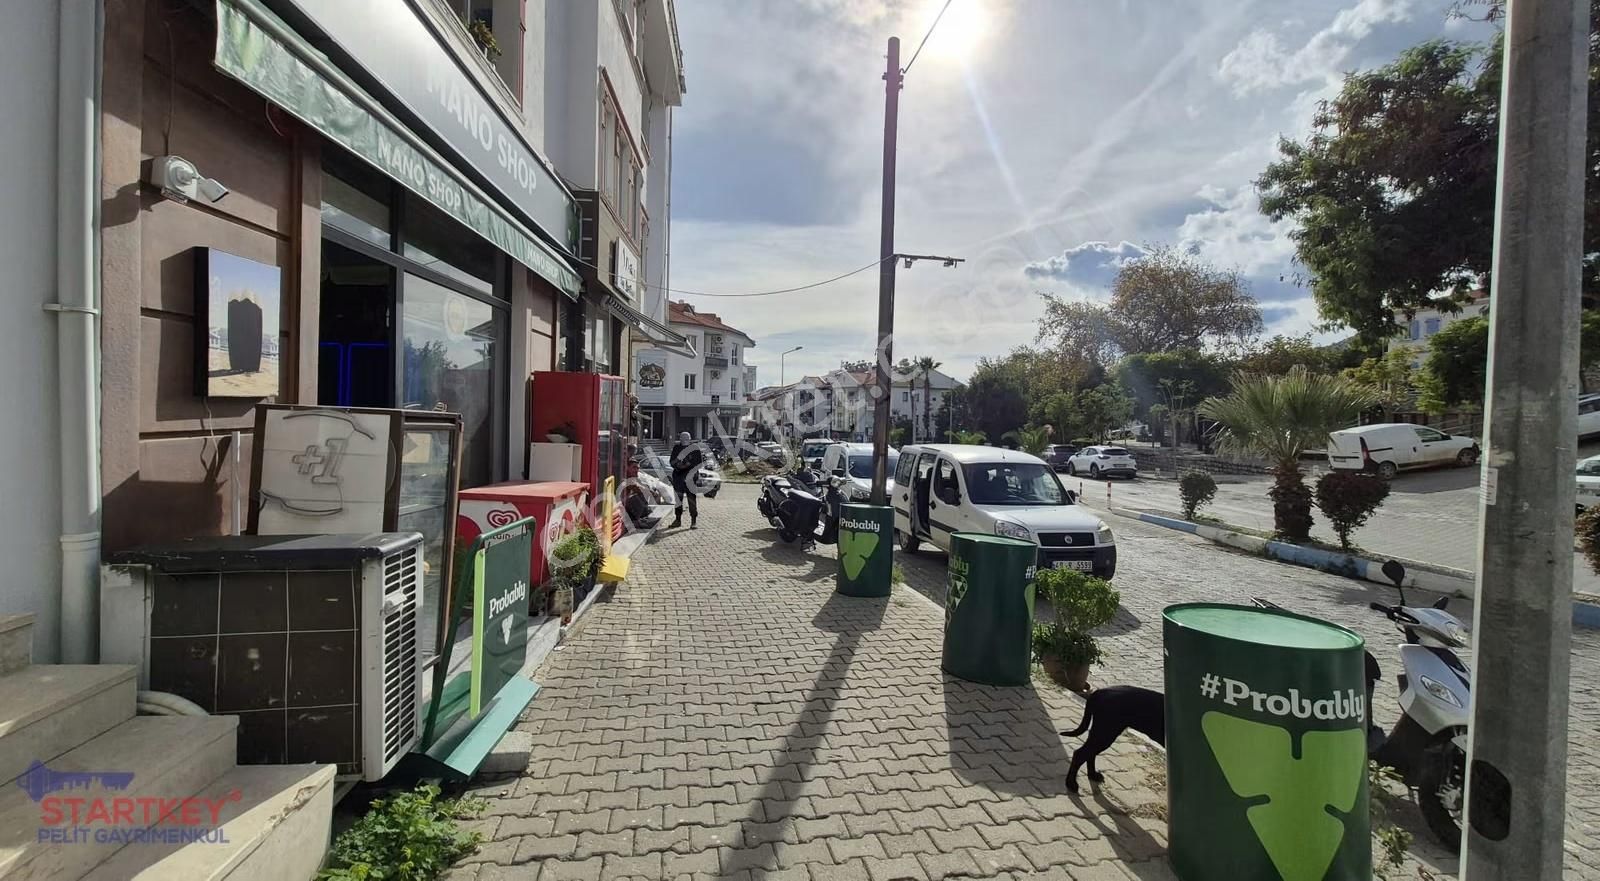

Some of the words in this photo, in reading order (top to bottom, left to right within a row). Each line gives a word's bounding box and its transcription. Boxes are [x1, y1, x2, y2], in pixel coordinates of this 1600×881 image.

[426, 62, 494, 151] MANO
[498, 134, 537, 195] SHOP
[378, 135, 425, 186] MANO
[428, 173, 462, 210] SHOP
[489, 580, 526, 619] Probably
[1200, 672, 1364, 723] #Probably
